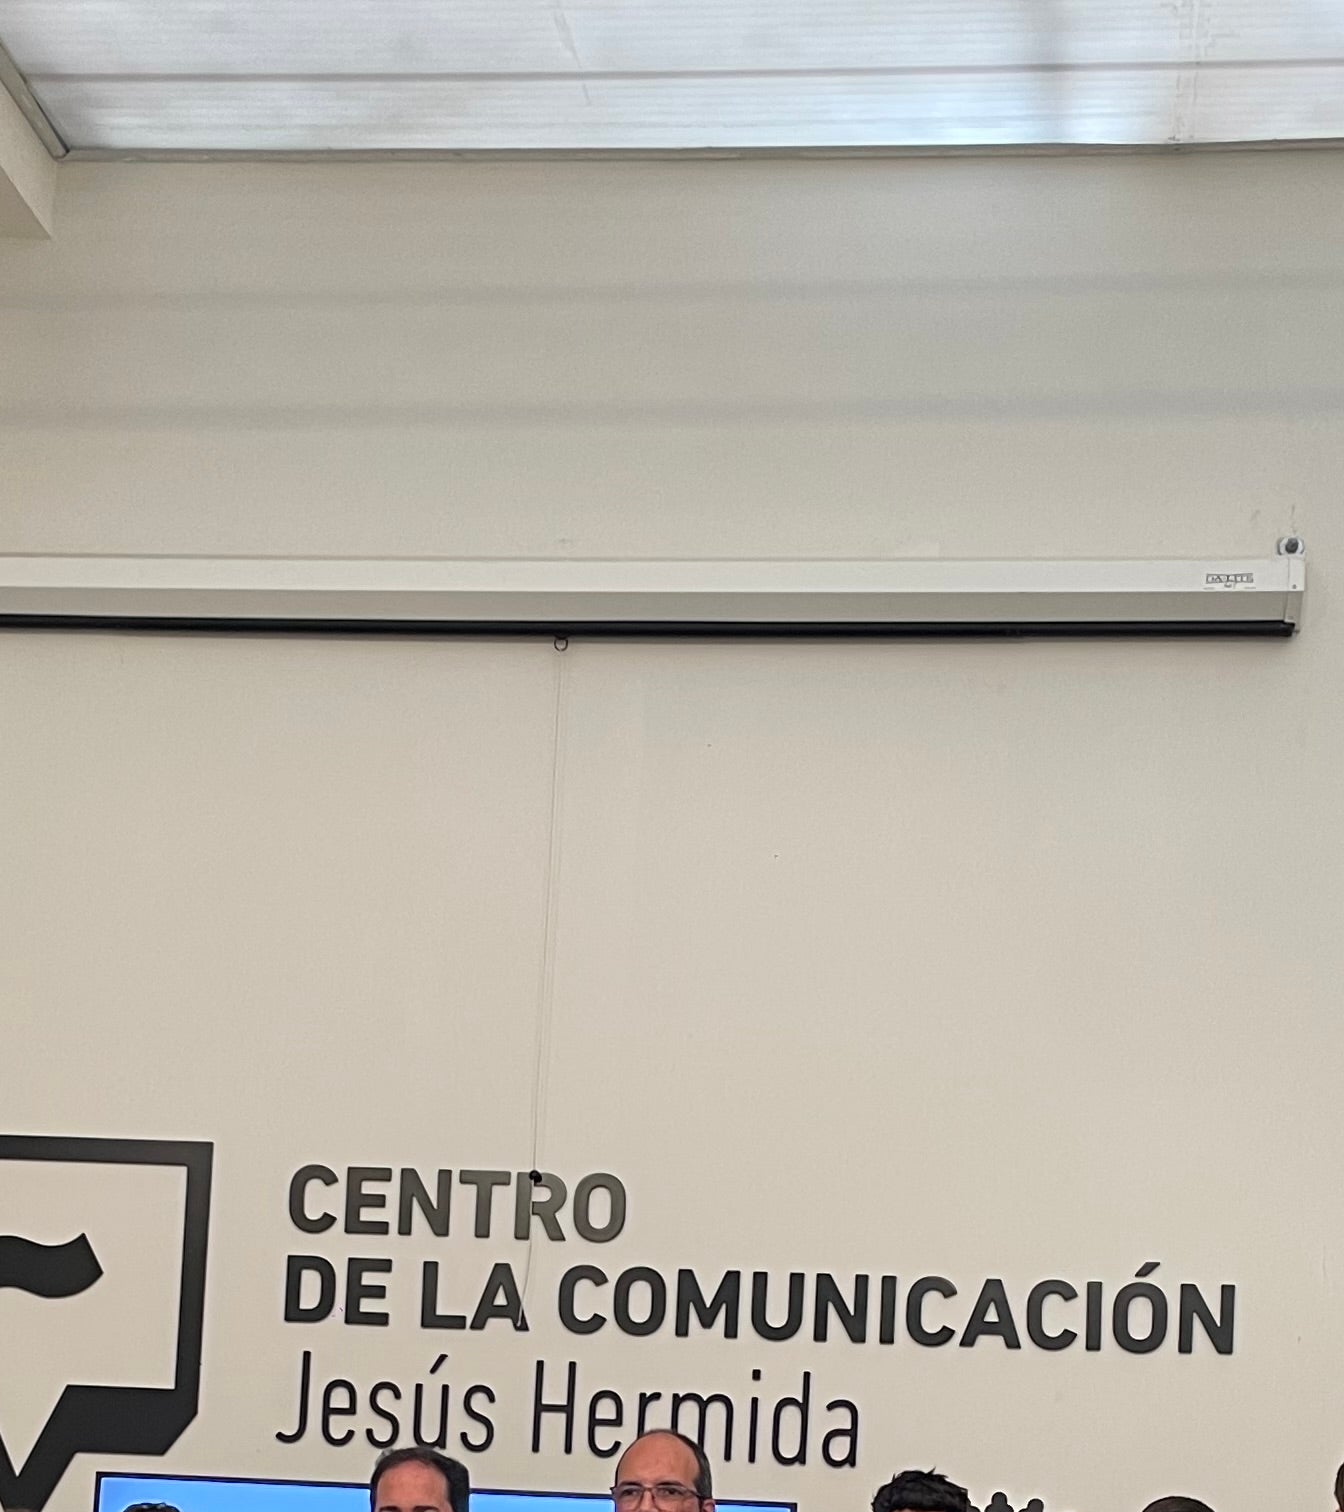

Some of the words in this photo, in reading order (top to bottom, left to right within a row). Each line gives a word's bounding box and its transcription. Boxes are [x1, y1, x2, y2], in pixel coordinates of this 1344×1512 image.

[289, 1164, 626, 1243] CENTRO
[284, 1255, 392, 1325] DE
[420, 1261, 529, 1332] LA
[558, 1261, 1236, 1355] COMUNICACIÓN
[275, 1350, 496, 1453] Jesús
[532, 1360, 859, 1468] Hermida
